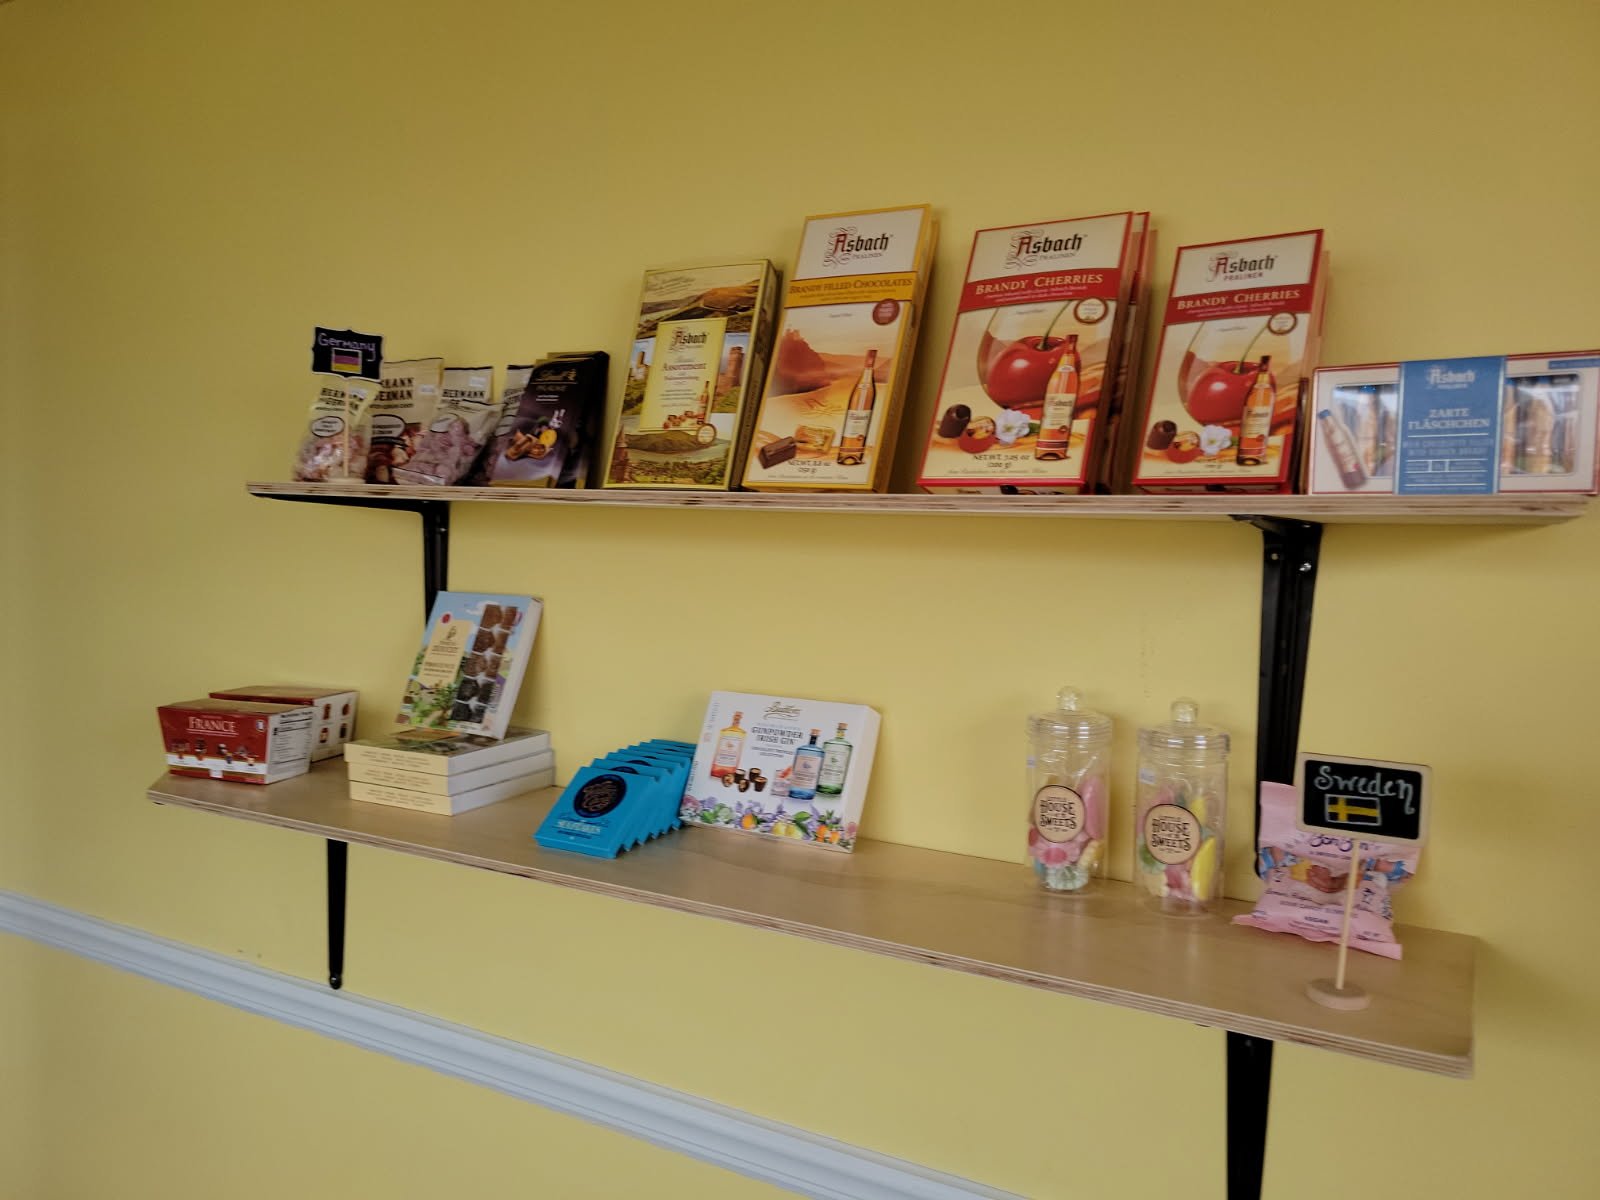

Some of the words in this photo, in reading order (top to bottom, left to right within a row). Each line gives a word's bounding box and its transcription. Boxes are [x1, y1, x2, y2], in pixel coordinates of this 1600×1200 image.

[828, 229, 890, 257] Asbach
[1011, 231, 1084, 260] Asbach
[1211, 252, 1275, 277] Asbach
[975, 279, 1029, 295] BRANDY
[1033, 274, 1104, 288] CHERRIES
[1176, 297, 1228, 310] BRANDY
[1233, 289, 1300, 303] CHERRIES
[318, 332, 377, 362] Germany
[188, 716, 236, 733] FRANCE
[1313, 765, 1416, 815] Sweden
[1040, 799, 1075, 815] HOUSE
[1039, 814, 1077, 830] SWEETS
[1151, 818, 1190, 837] HOUSE
[1151, 833, 1191, 851] SWEETS
